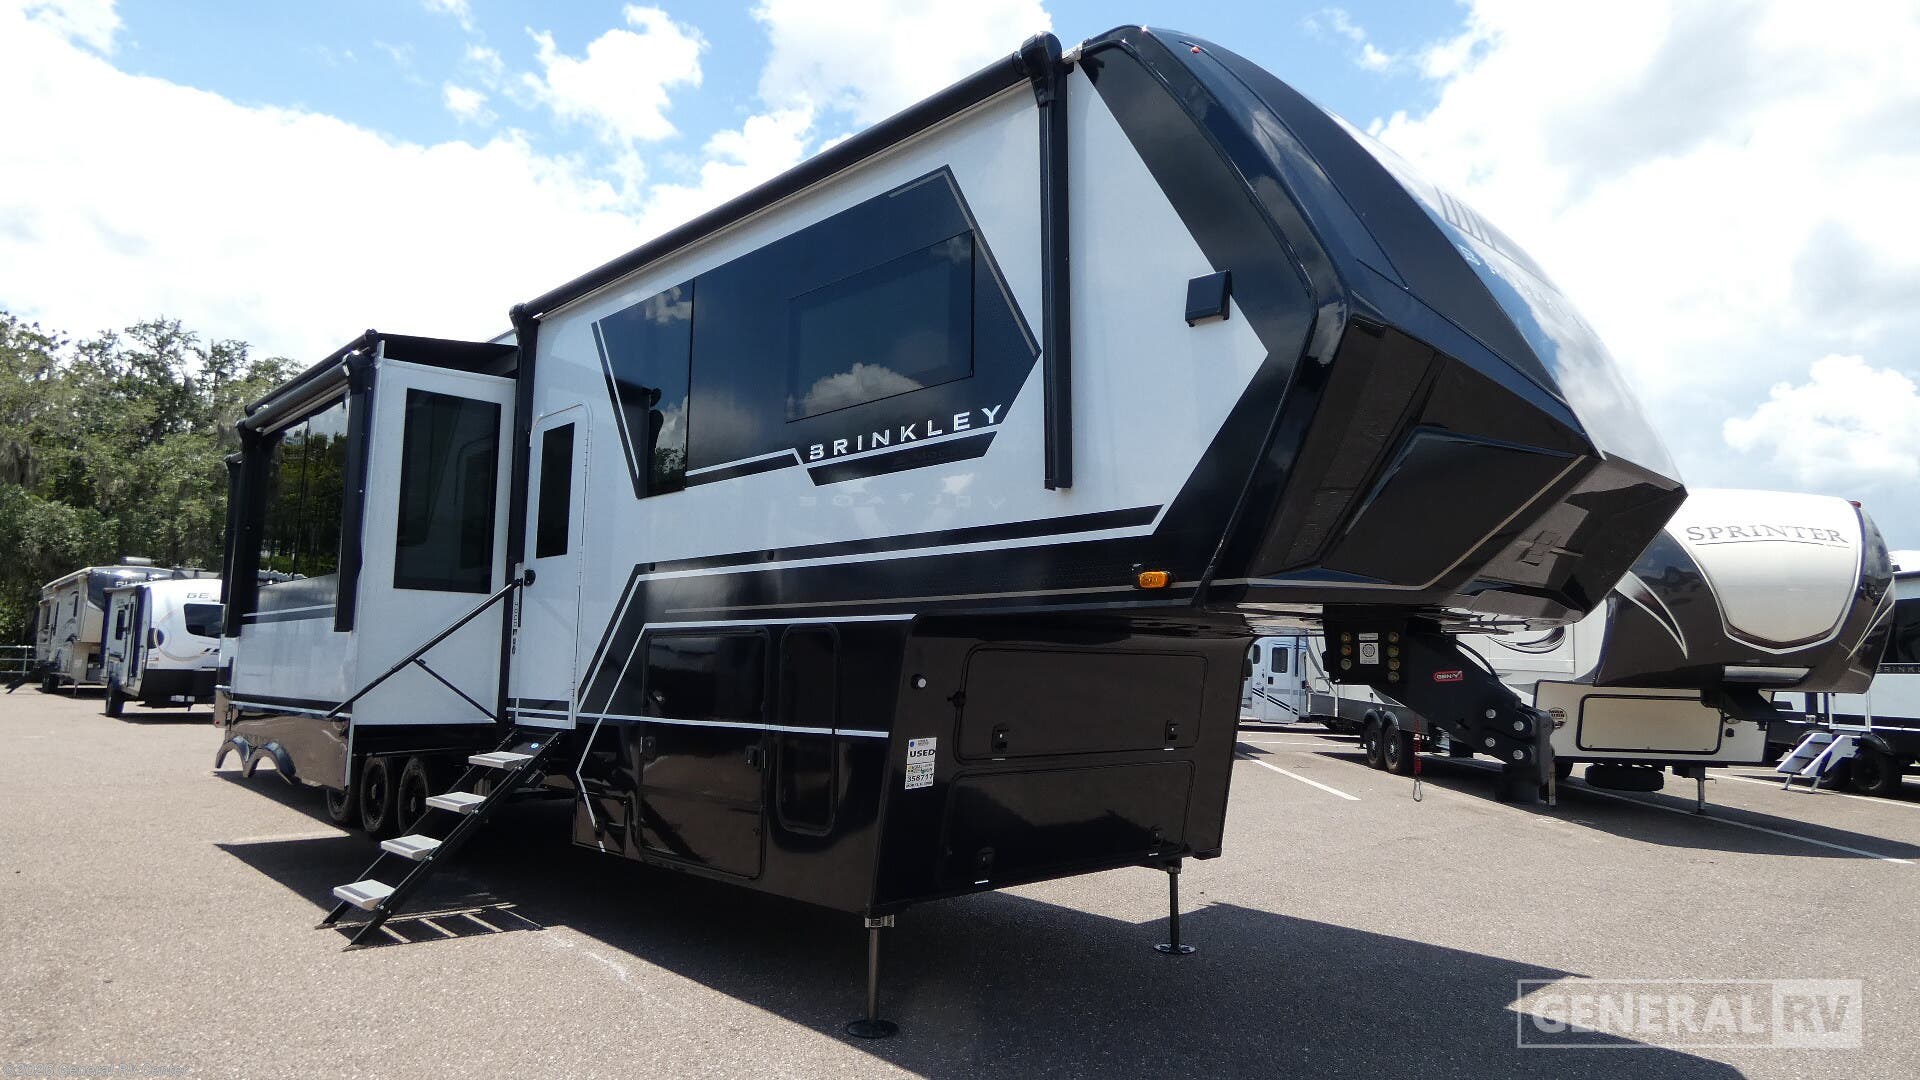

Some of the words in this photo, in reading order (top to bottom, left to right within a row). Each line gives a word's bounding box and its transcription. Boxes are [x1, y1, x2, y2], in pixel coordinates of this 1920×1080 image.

[809, 404, 1002, 460] BRINKLEY
[1686, 524, 1849, 544] SPRINTER
[910, 749, 936, 757] USED
